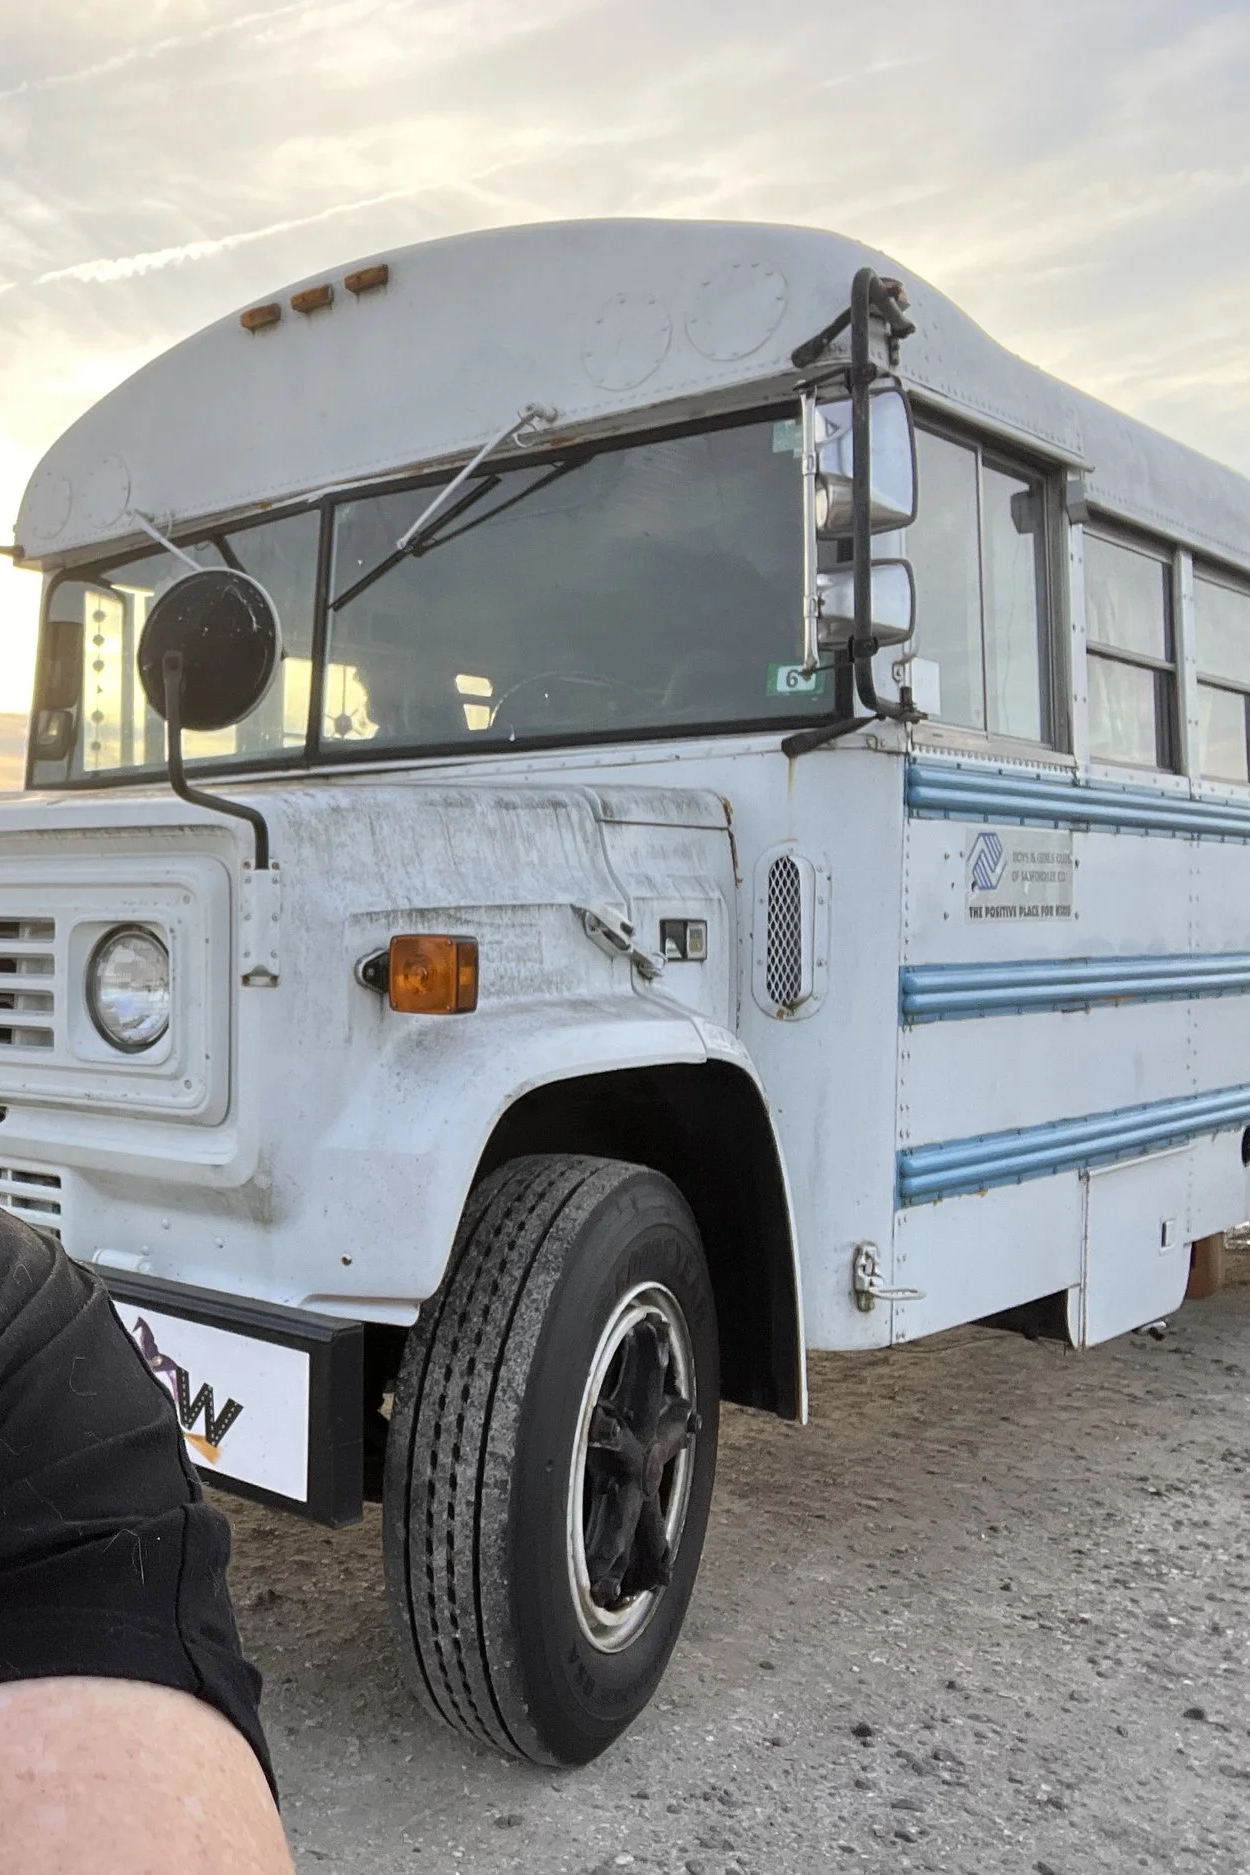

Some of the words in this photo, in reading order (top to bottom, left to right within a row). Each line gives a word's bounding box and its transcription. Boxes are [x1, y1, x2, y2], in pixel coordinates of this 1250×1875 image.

[969, 906, 983, 919] THE
[985, 905, 1017, 918] POSITIVE
[1019, 905, 1039, 918] PLACE
[1041, 905, 1054, 917] FOR
[1056, 904, 1071, 917] KIDS
